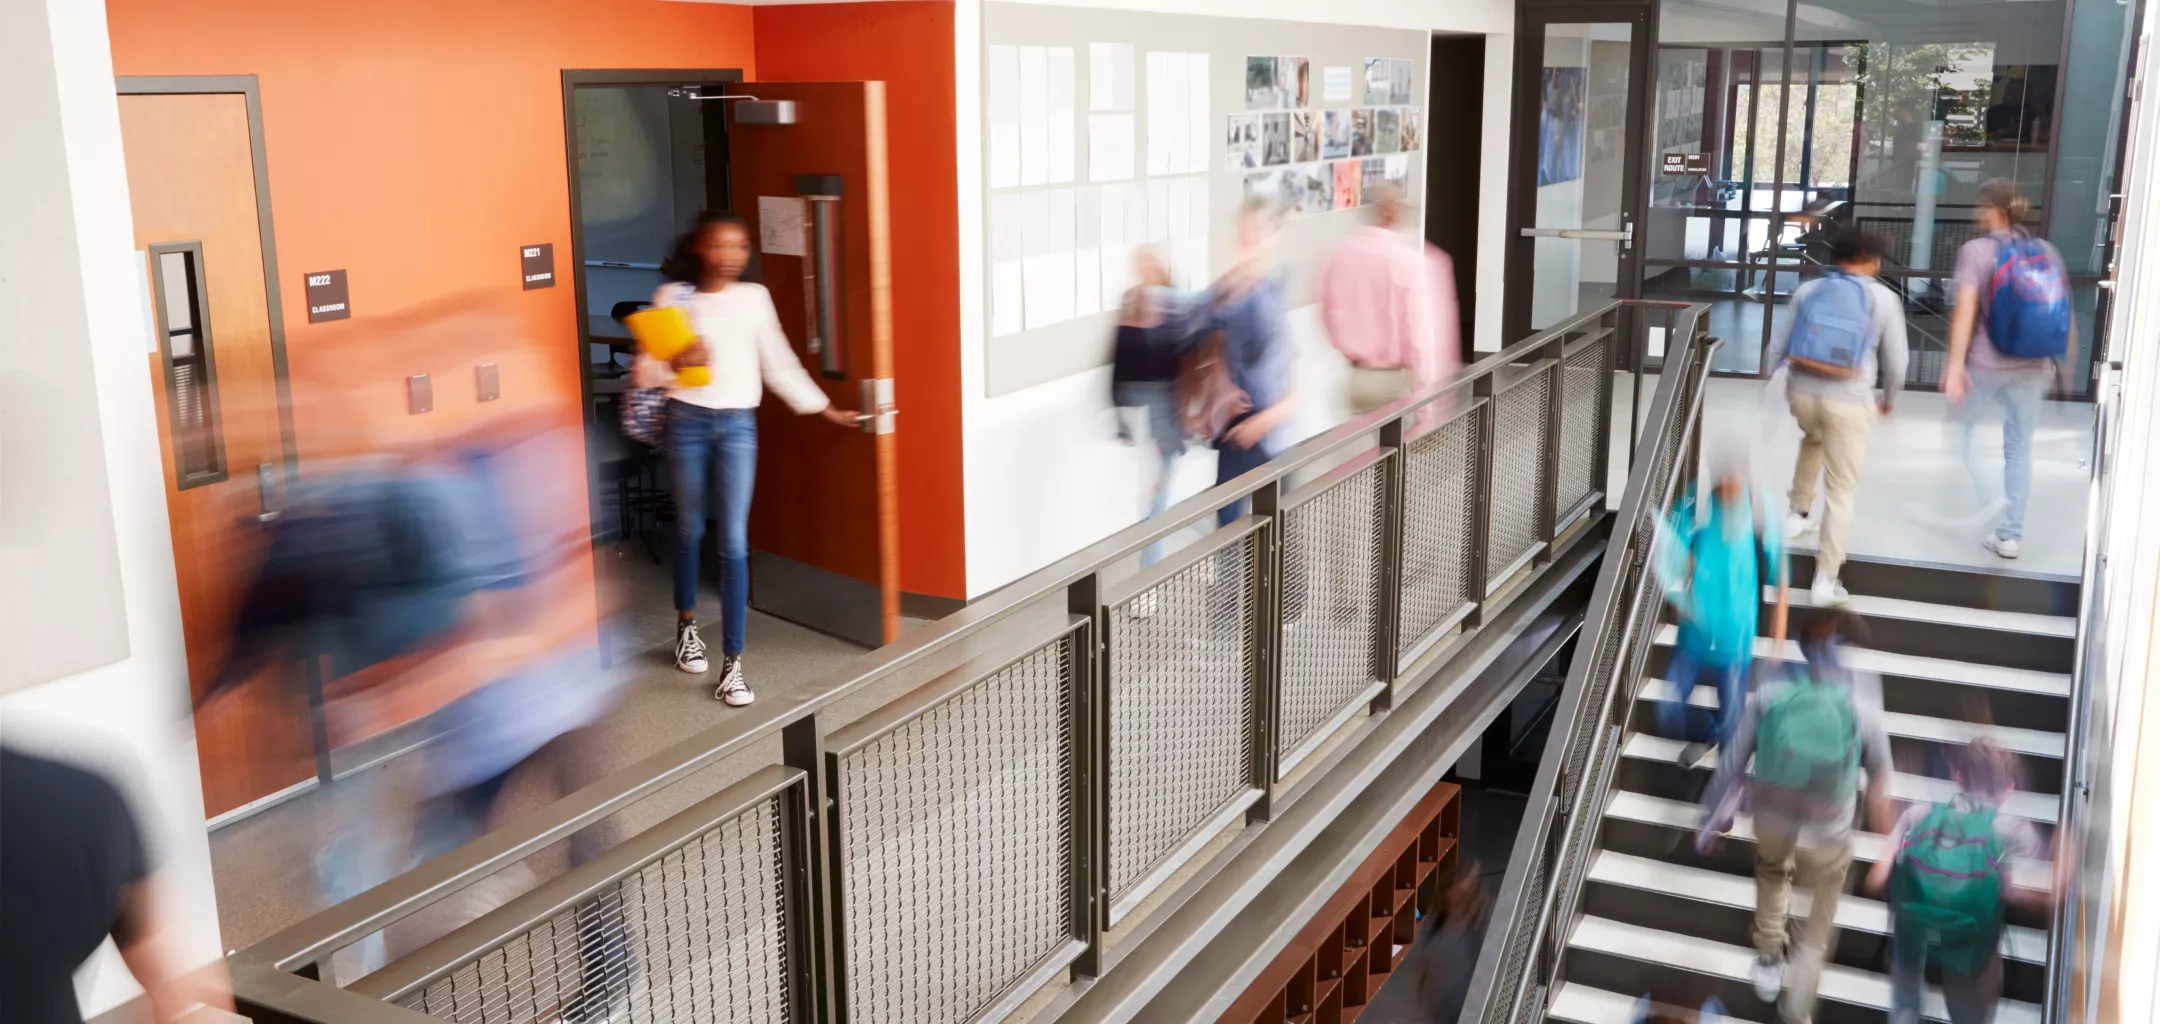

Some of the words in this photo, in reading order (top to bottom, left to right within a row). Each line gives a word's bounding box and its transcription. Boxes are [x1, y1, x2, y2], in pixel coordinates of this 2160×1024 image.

[1667, 156, 1682, 164] EXIT
[1664, 164, 1685, 172] ROUTE
[523, 247, 540, 258] M221
[309, 274, 331, 287] M222
[525, 272, 551, 282] CLASSROOM
[312, 302, 345, 313] CLASSROOM
